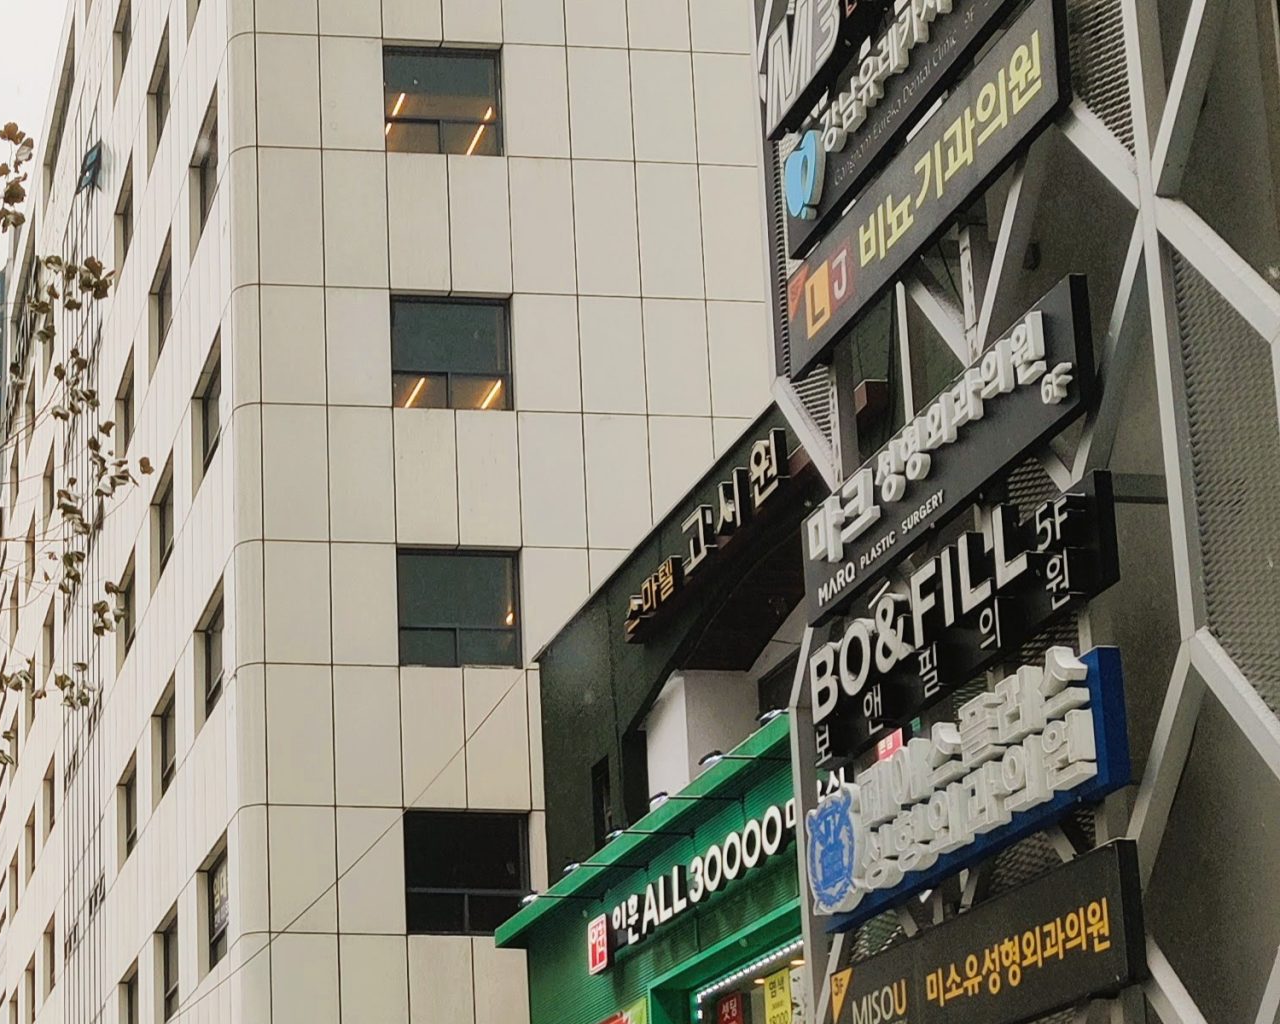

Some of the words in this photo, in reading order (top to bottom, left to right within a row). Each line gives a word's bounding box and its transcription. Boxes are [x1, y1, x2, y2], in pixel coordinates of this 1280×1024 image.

[820, 0, 952, 152] 강남유레카
[859, 30, 1042, 268] 비뇨기과의원
[902, 60, 932, 104] Dental
[681, 430, 780, 576] 고시원
[807, 311, 1047, 563] 마크성형외과의원
[1041, 362, 1073, 404] 6F
[809, 504, 1028, 725] BO&FILL
[1035, 497, 1069, 550] 5F
[817, 563, 856, 607] MARQ
[859, 530, 897, 571] PLASTIC
[901, 489, 946, 535] SURGERY
[864, 709, 1098, 890] 성형외과의원
[926, 897, 1111, 1007] 미소유성형외과의원
